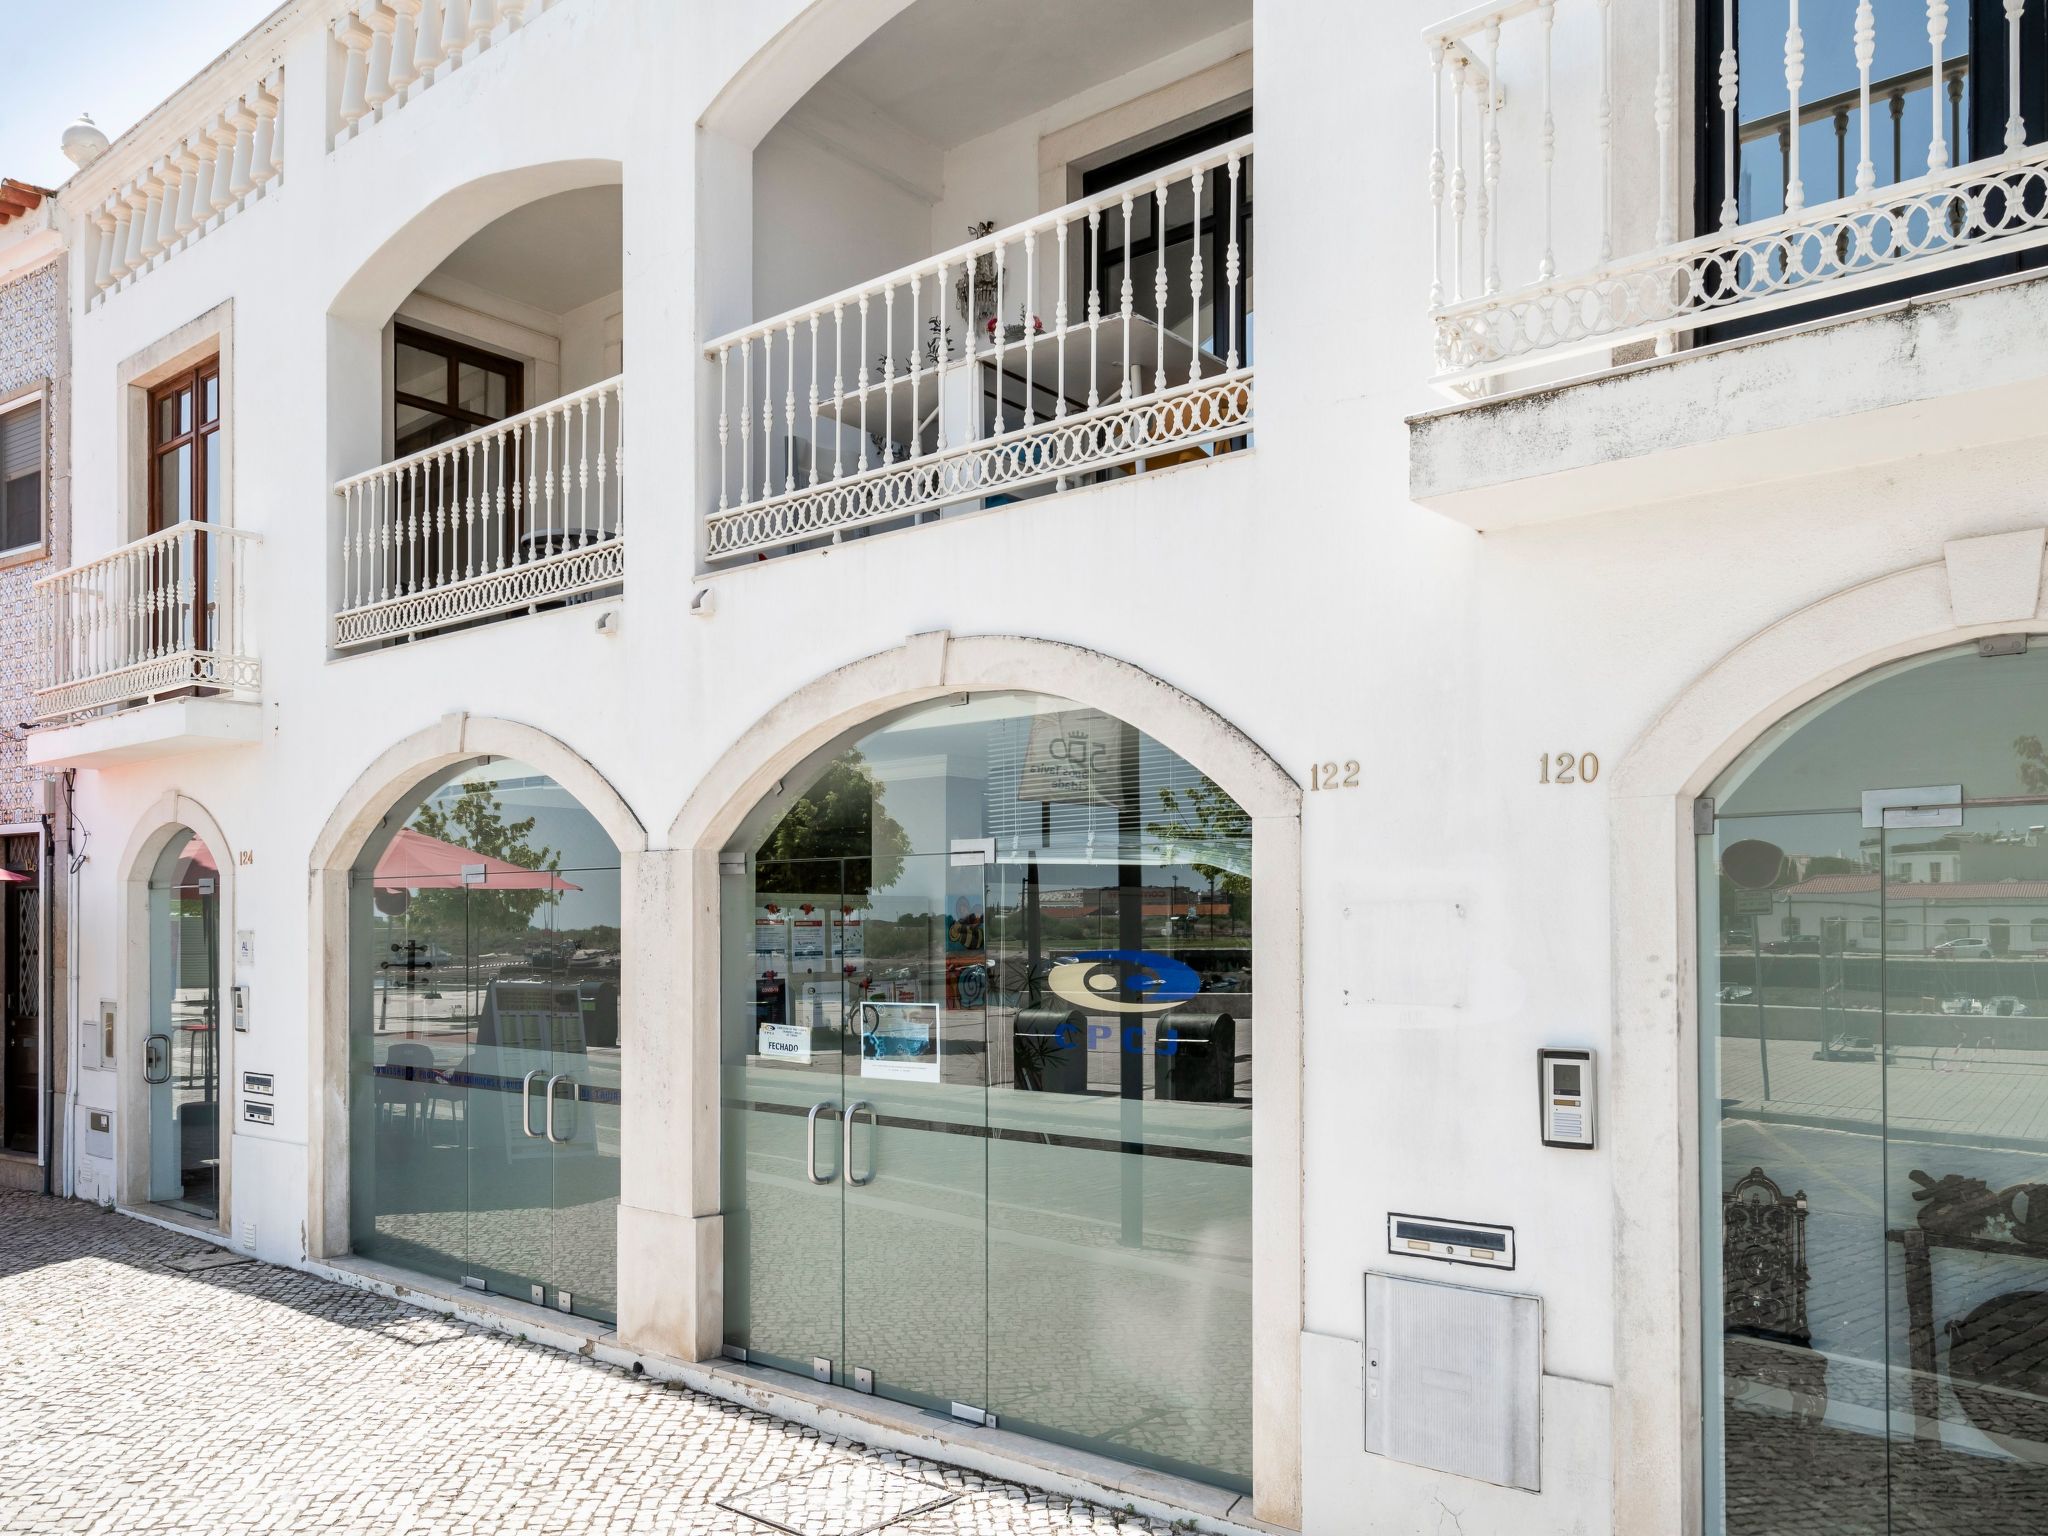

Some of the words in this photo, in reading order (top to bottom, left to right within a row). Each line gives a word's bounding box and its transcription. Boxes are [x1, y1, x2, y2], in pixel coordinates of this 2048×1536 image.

[1310, 760, 1361, 791] 122
[1539, 752, 1599, 784] 120
[239, 848, 254, 866] 124
[241, 941, 249, 952] AL
[768, 1042, 799, 1052] FECHADO
[1055, 1022, 1179, 1056] CPCJ
